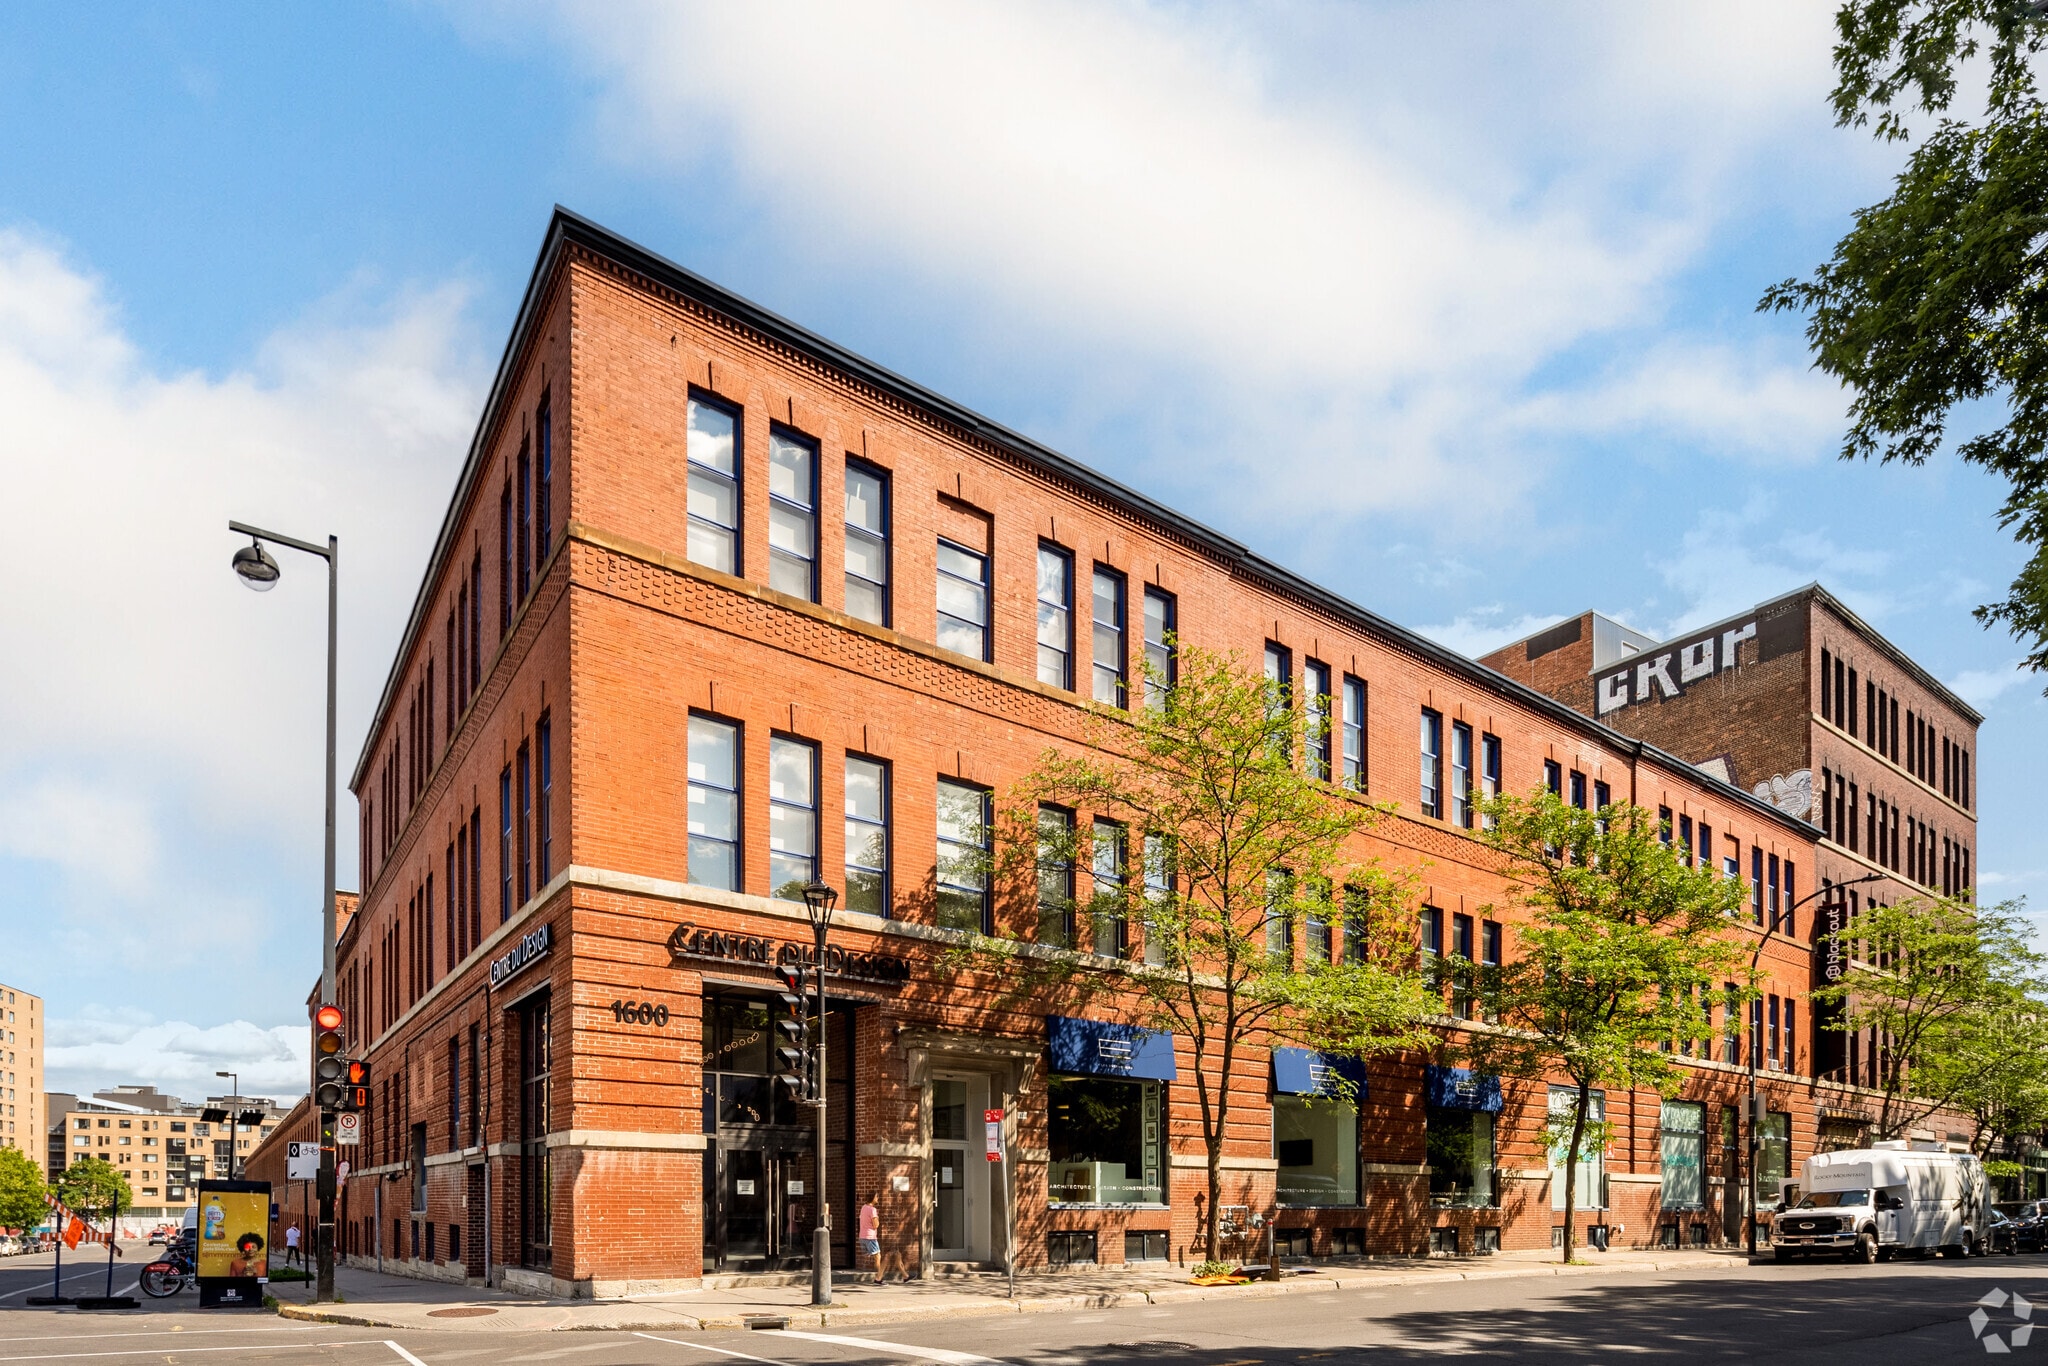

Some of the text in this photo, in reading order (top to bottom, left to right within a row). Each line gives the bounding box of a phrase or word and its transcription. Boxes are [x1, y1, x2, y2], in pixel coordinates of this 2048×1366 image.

[490, 923, 548, 985] CENTRE DU DESIGN
[675, 921, 776, 961] CENTRE
[827, 943, 910, 980] DESIGN
[1826, 908, 1840, 965] blackout
[610, 999, 669, 1028] 1600
